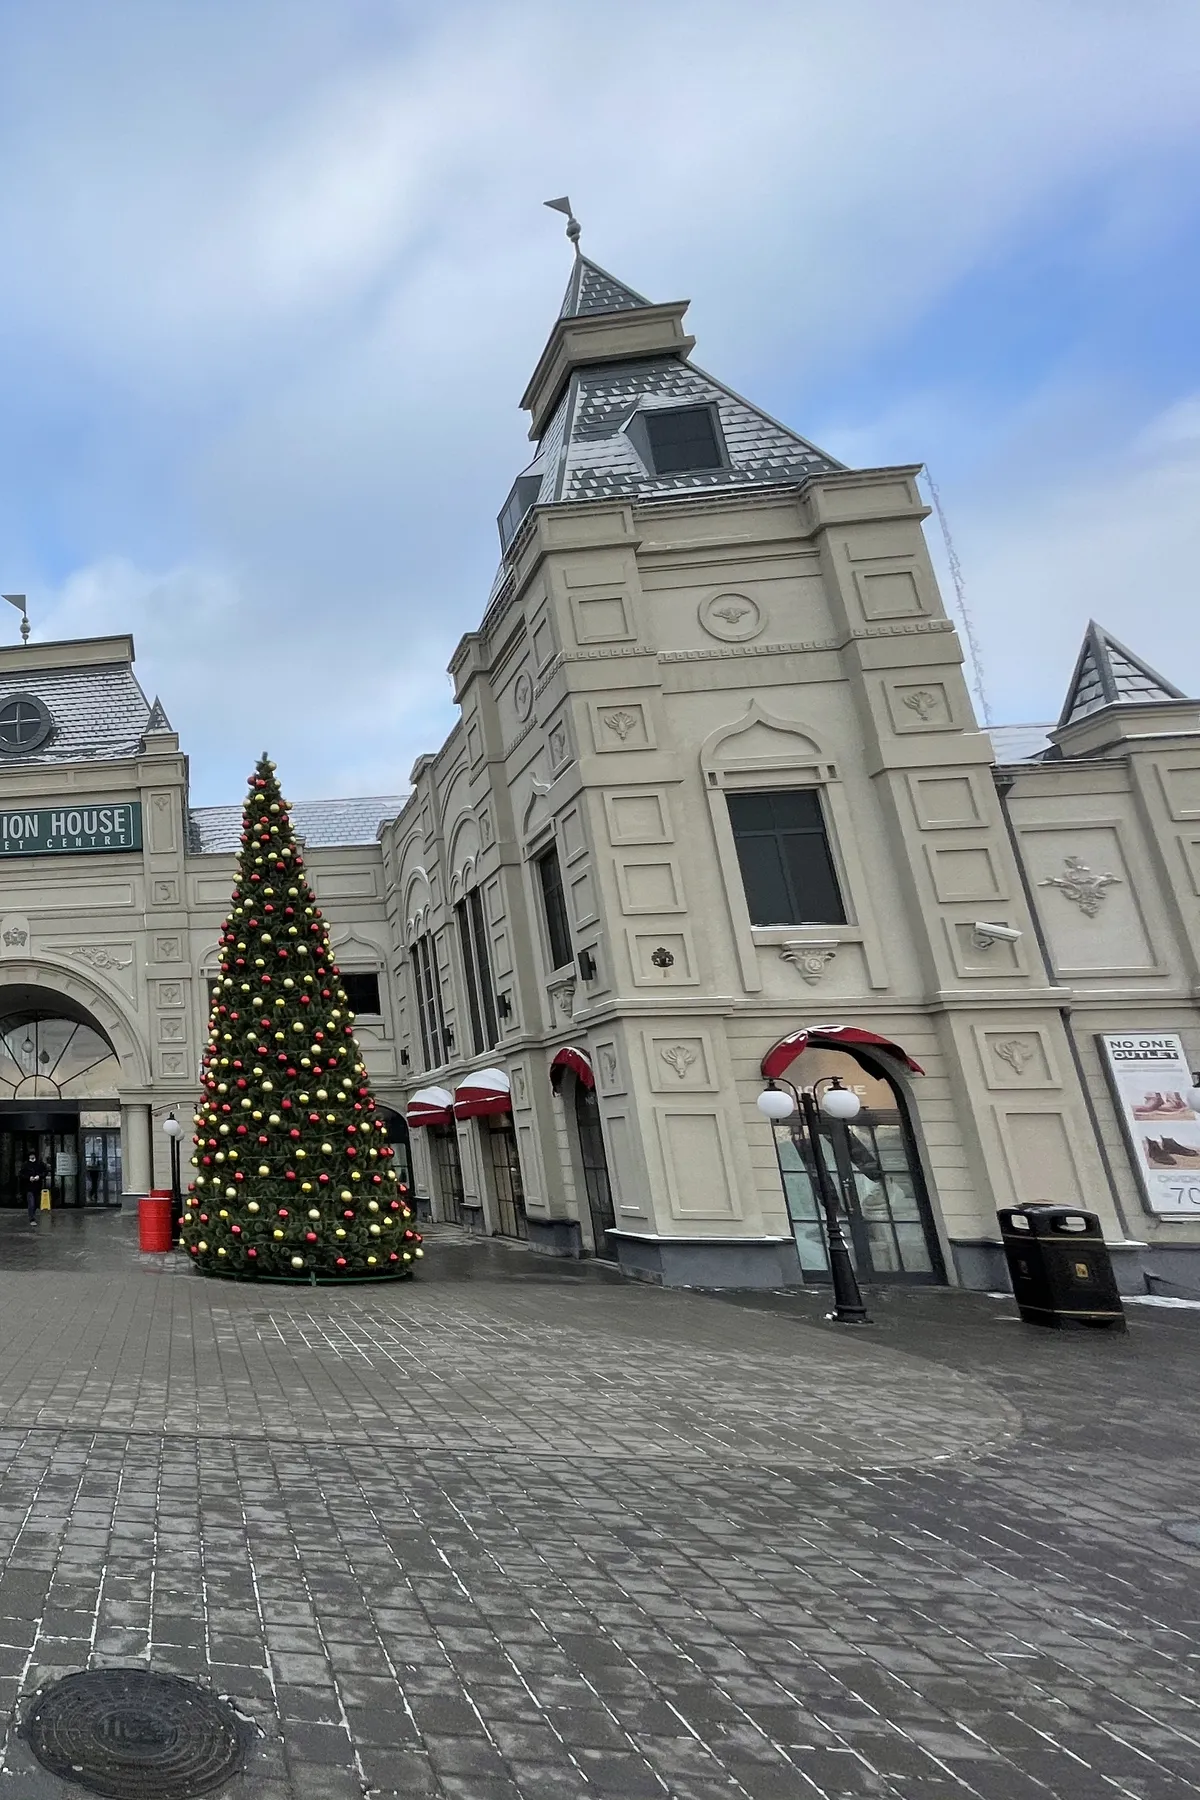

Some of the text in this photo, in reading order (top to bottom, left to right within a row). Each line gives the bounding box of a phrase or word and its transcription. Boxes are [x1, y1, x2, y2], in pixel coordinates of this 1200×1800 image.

[51, 809, 126, 836] HOUSE
[46, 834, 126, 848] CENTRE
[1109, 1040, 1176, 1049] NO ONE
[1113, 1050, 1179, 1060] OUTLET
